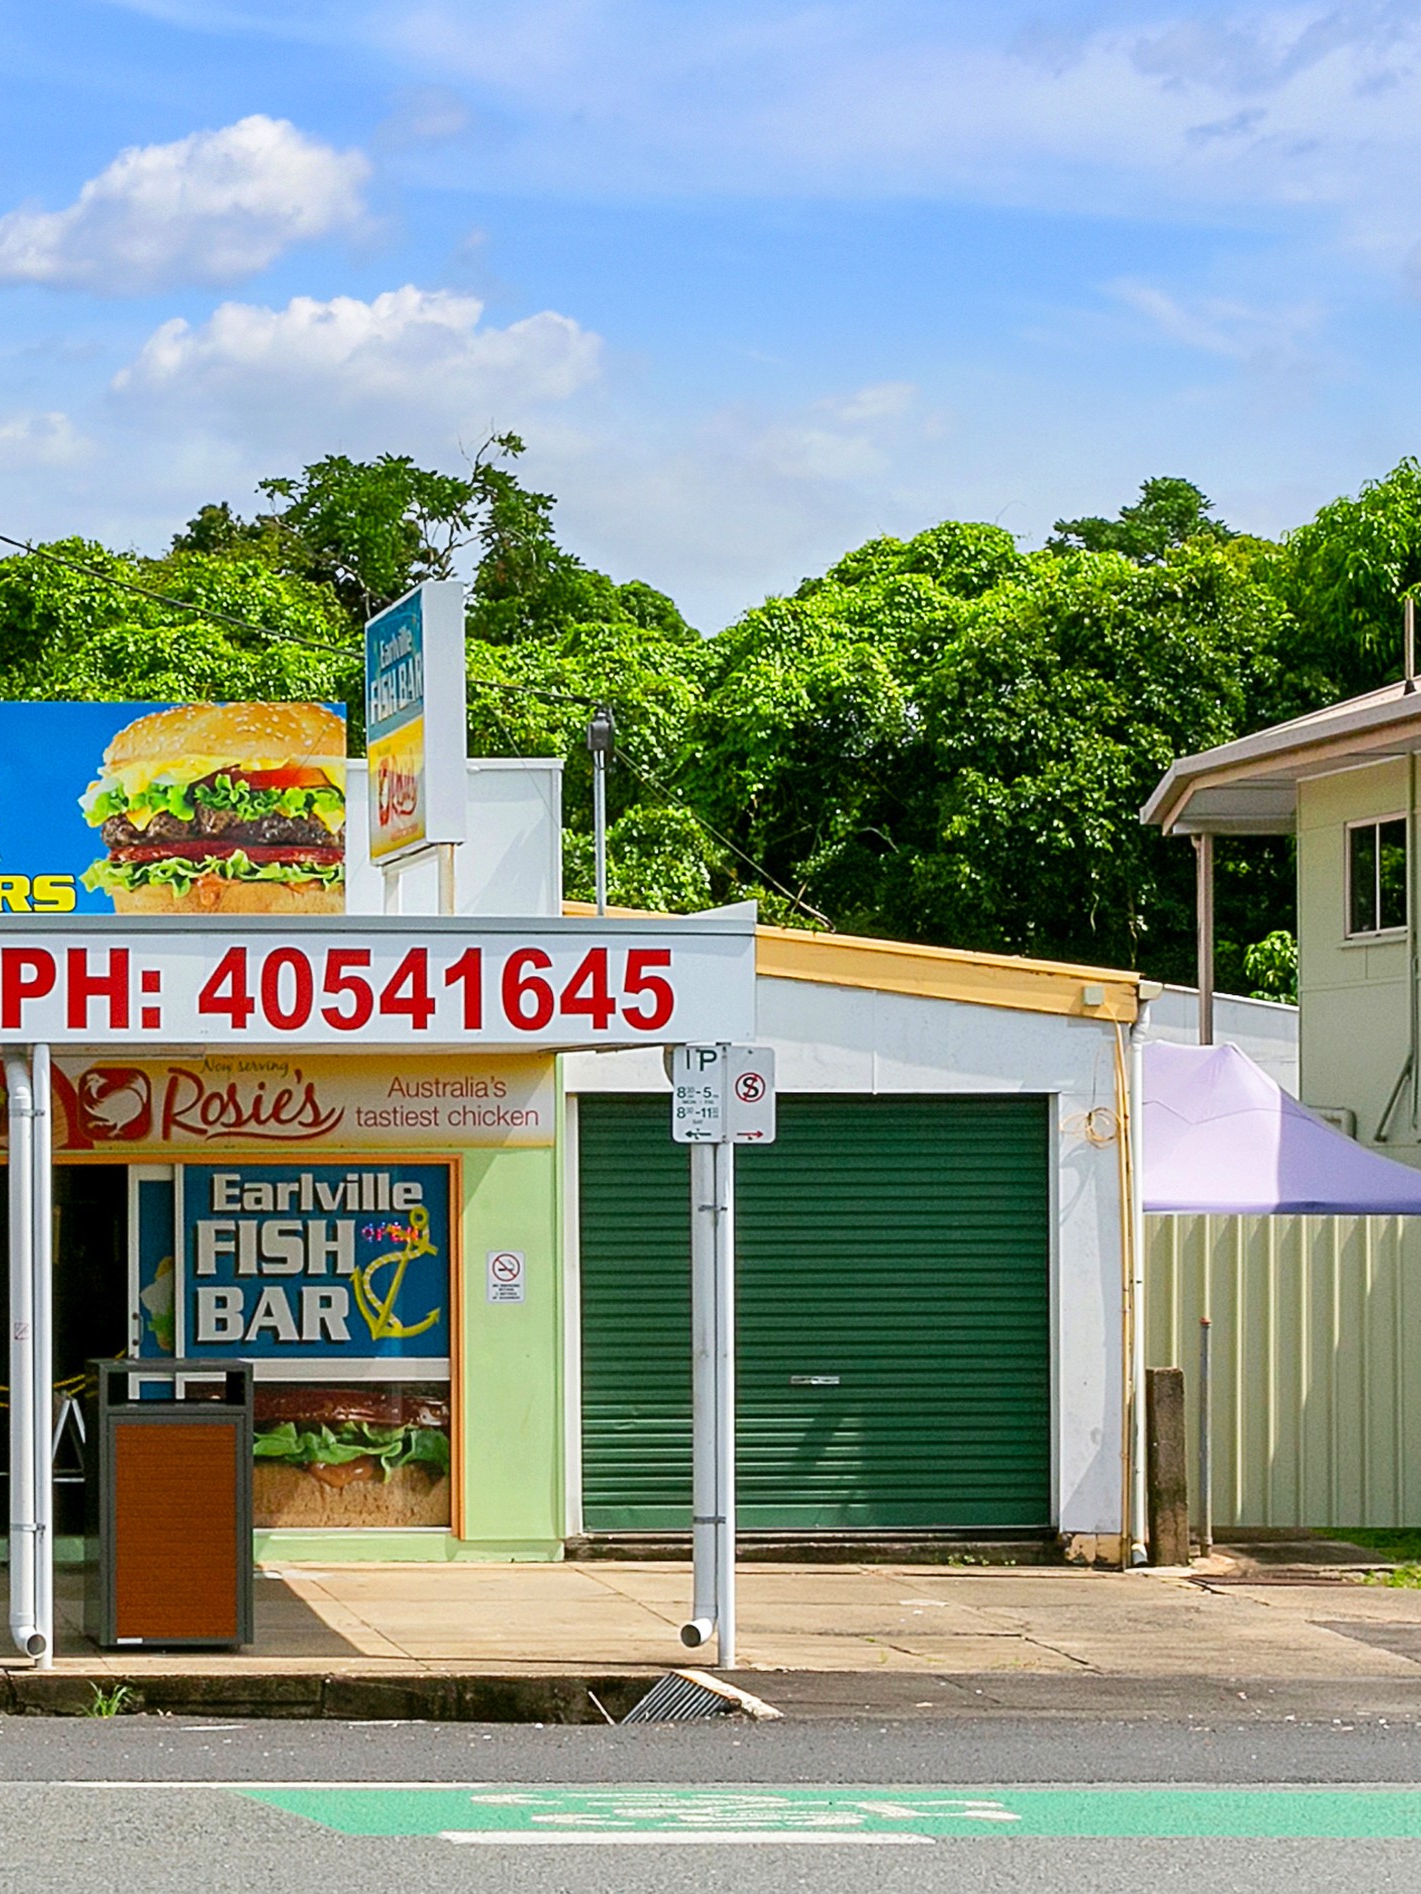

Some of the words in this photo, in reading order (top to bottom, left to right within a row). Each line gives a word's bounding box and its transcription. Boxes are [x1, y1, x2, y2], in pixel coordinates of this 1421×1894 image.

[398, 652, 423, 709] BAR
[1, 948, 160, 1030] PH:
[198, 948, 674, 1032] 40541645
[201, 1059, 231, 1074] Now
[238, 1059, 289, 1077] serving
[386, 1076, 507, 1098] Australia's
[162, 1067, 345, 1142] Rosie's
[356, 1106, 440, 1127] tastiest
[447, 1105, 540, 1127] chicken
[212, 1173, 424, 1211] Earlville
[196, 1219, 356, 1276] FISH
[196, 1286, 352, 1342] BAR
